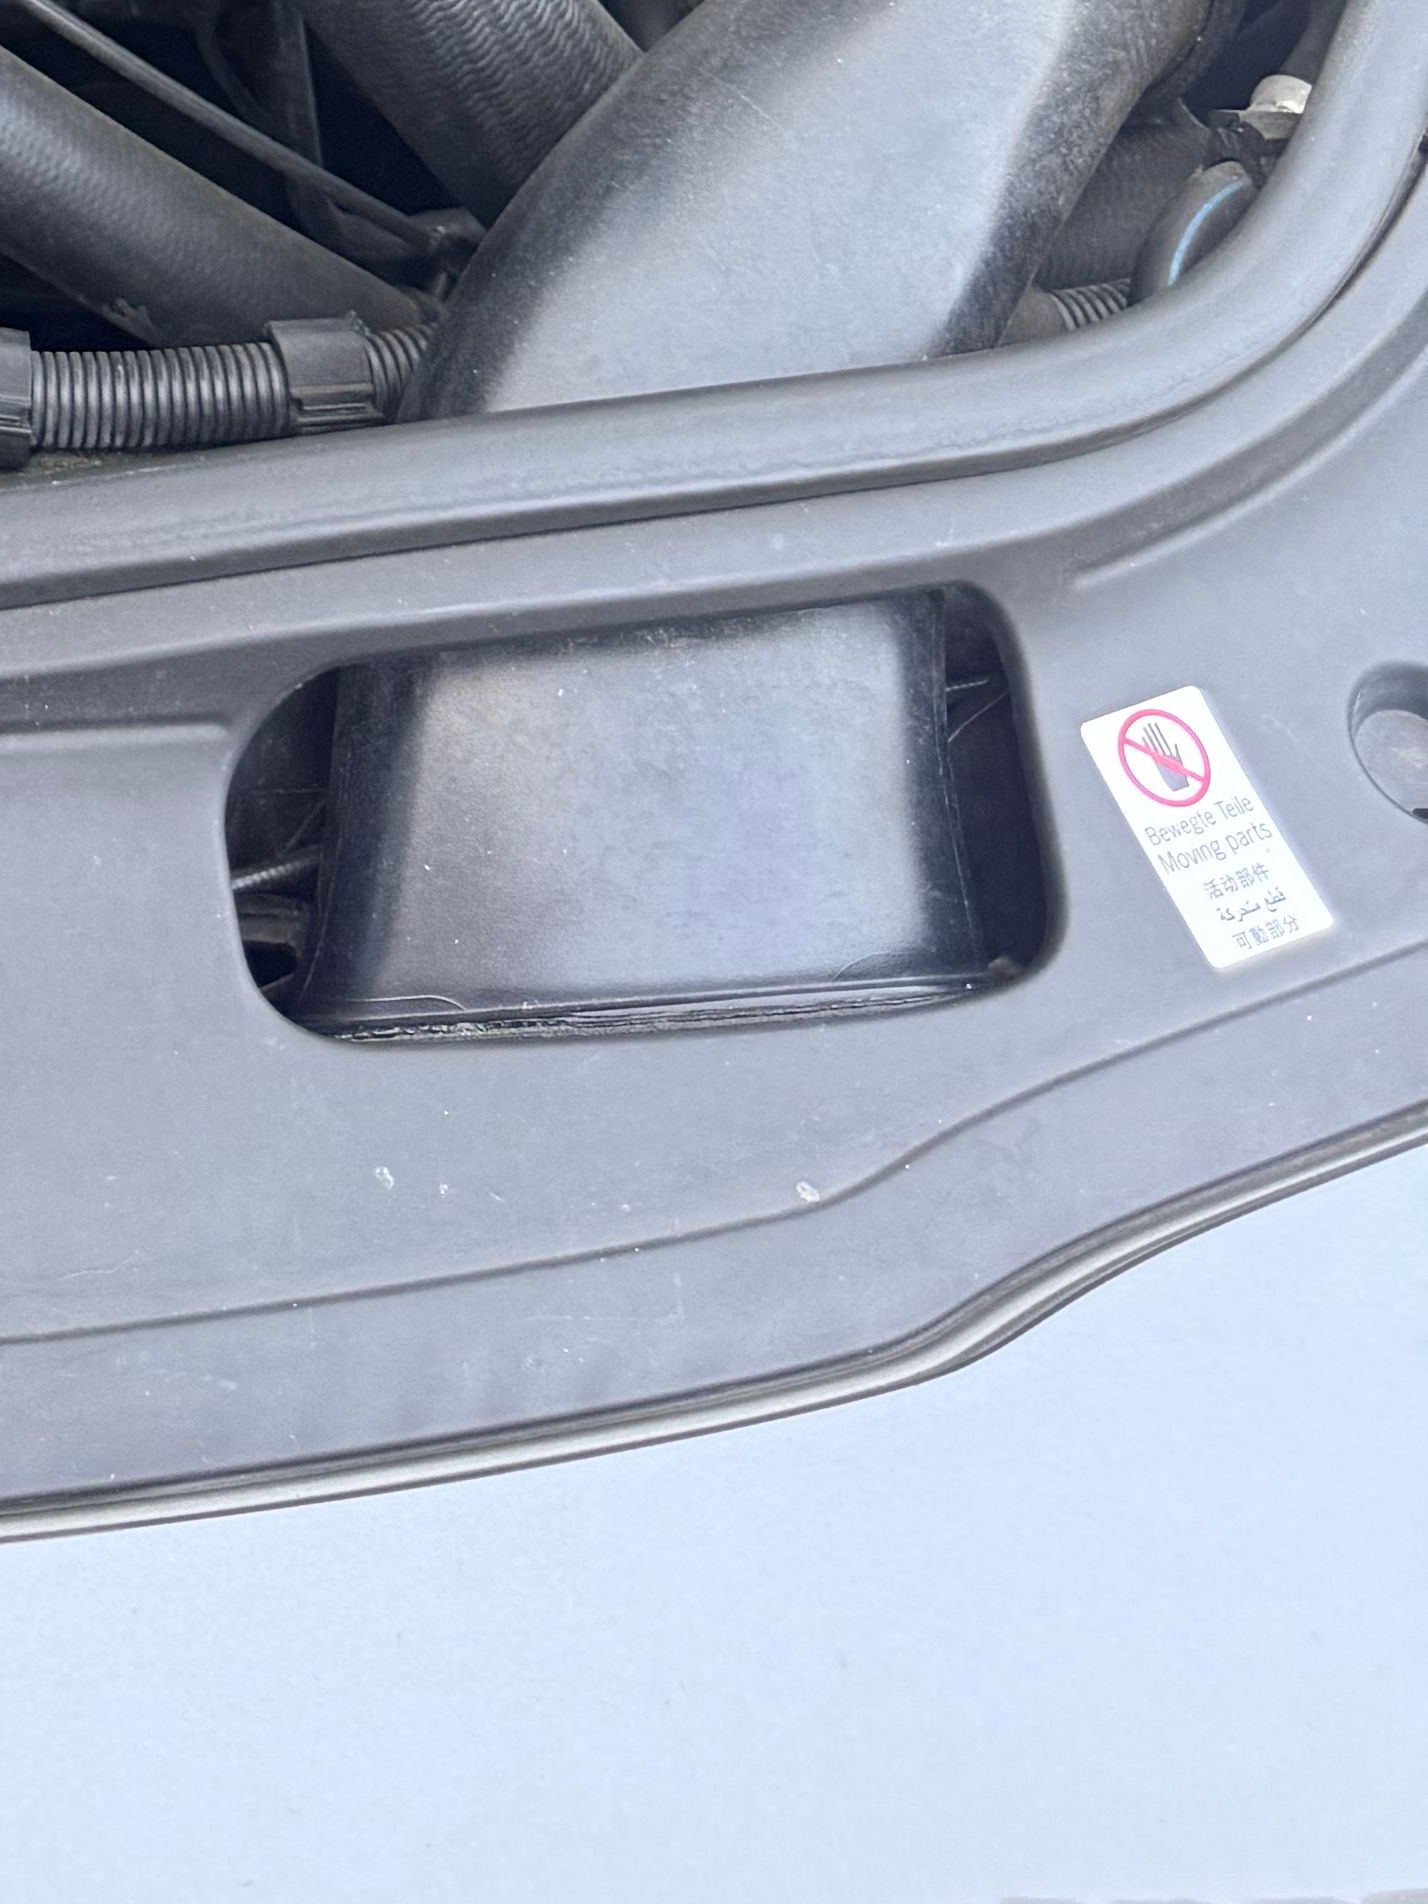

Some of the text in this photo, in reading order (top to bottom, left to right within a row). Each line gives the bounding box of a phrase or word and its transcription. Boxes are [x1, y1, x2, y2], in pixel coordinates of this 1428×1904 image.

[1144, 796, 1255, 846] Bewegte Teile
[1157, 822, 1274, 875] Moving parts
[1202, 862, 1270, 900] 活动部件
[1231, 914, 1301, 950] 可動部分
